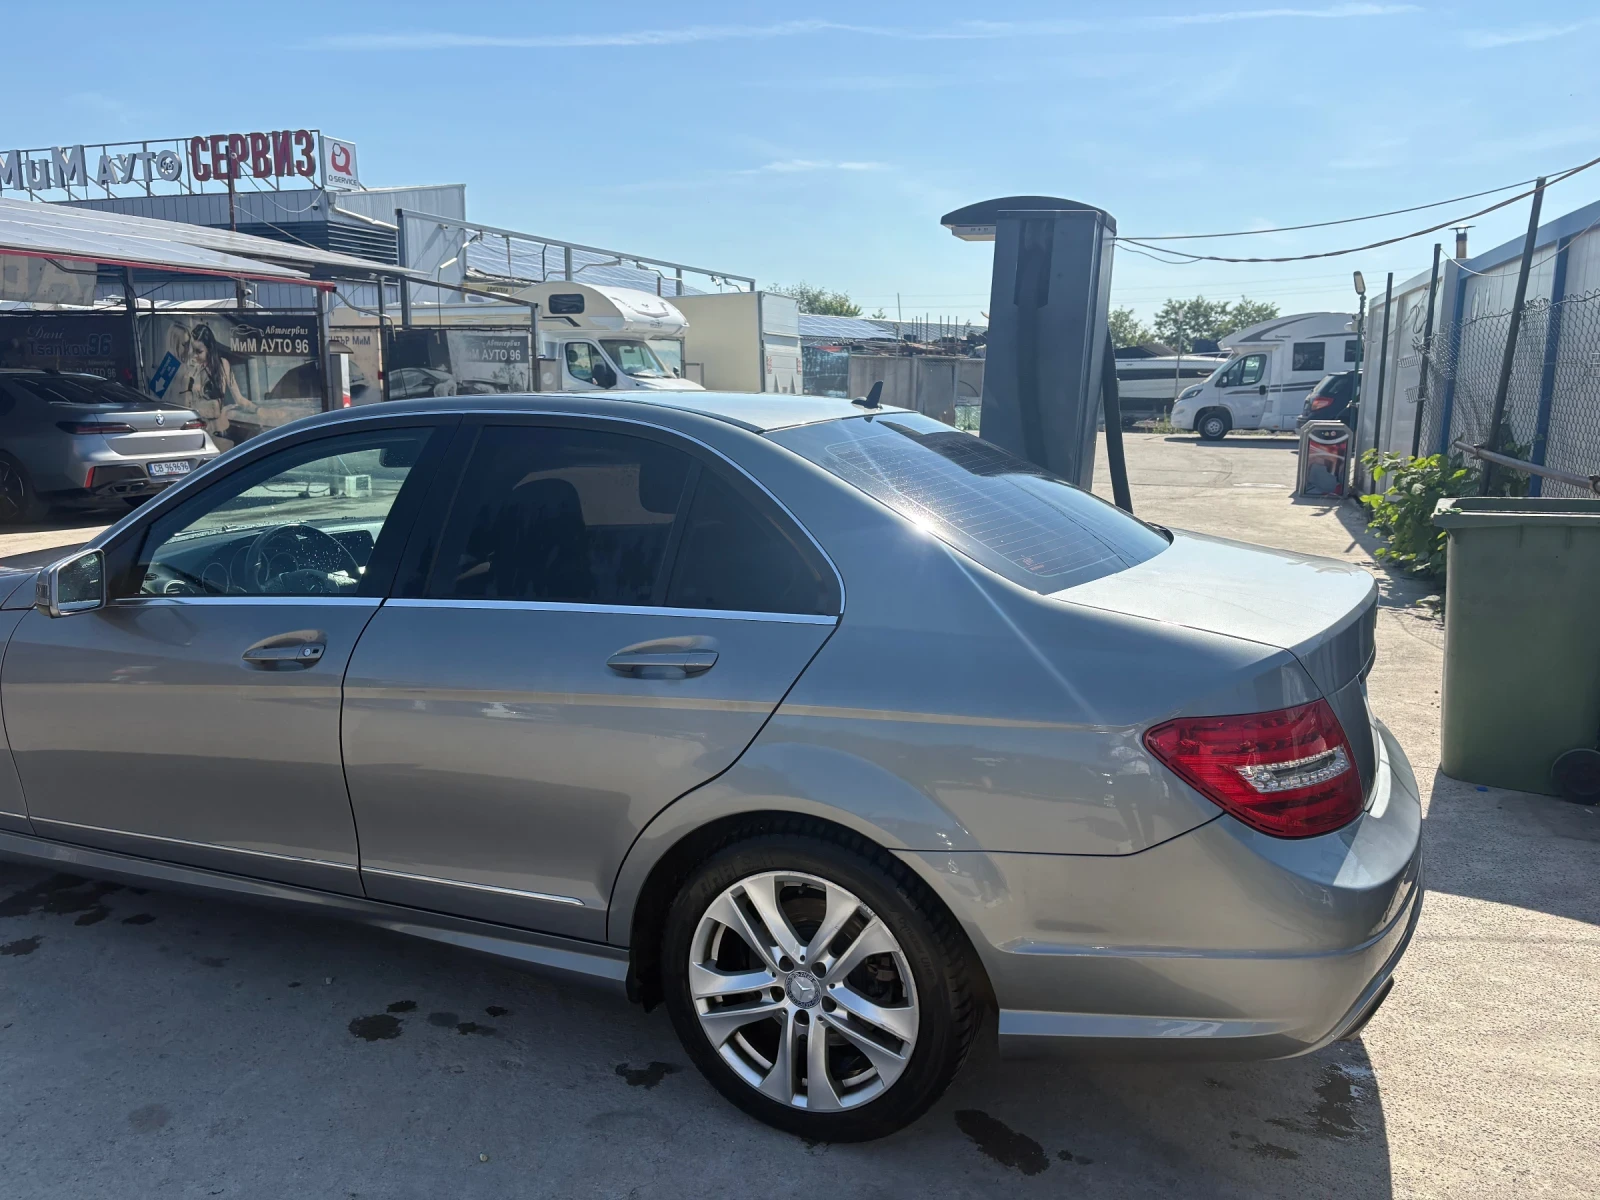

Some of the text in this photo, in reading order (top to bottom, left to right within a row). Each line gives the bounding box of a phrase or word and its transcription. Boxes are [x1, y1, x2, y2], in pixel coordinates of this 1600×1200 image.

[191, 129, 317, 181] СЕРВИЗ
[260, 338, 292, 353] АУТО
[295, 338, 309, 354] 96
[481, 349, 508, 361] АУТО
[509, 349, 521, 361] 96
